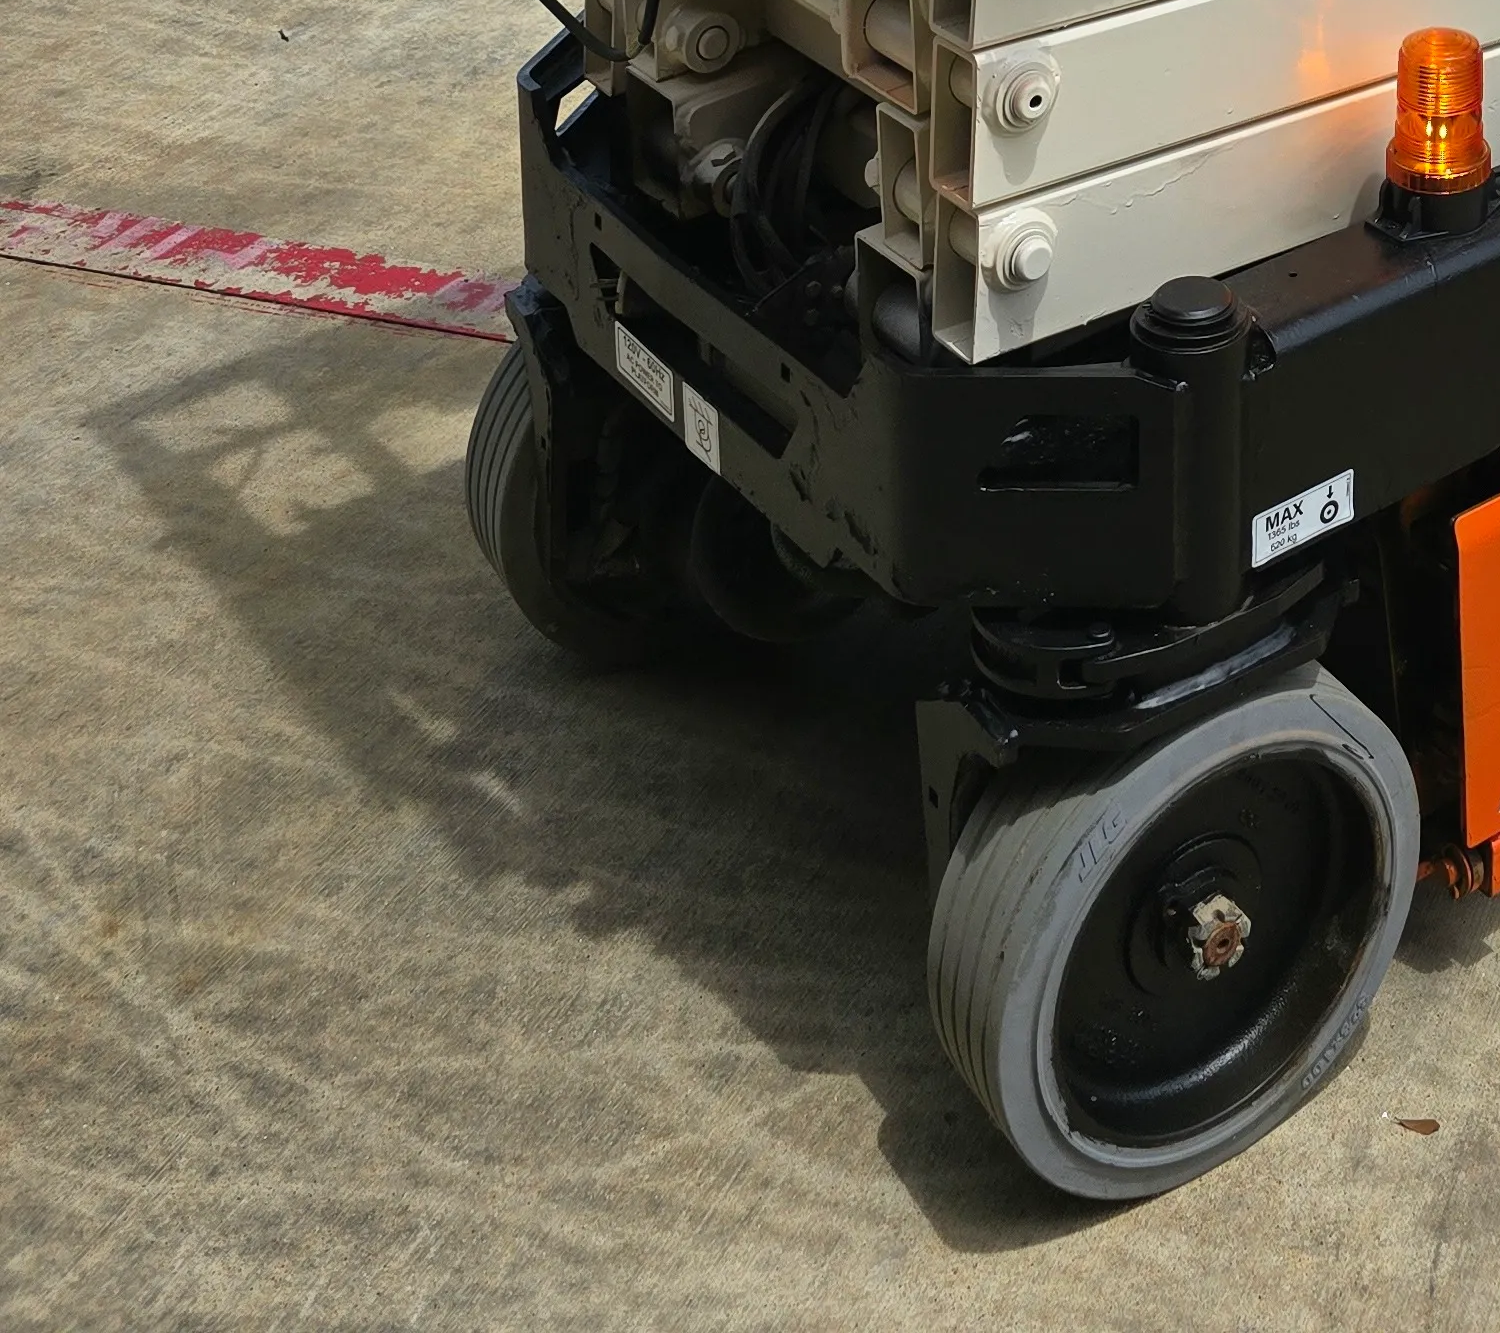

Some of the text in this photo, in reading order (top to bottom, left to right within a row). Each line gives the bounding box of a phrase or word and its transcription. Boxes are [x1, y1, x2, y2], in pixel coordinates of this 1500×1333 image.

[1265, 500, 1303, 532] MAX
[1288, 519, 1300, 531] lbs
[1270, 533, 1298, 552] 620 kg
